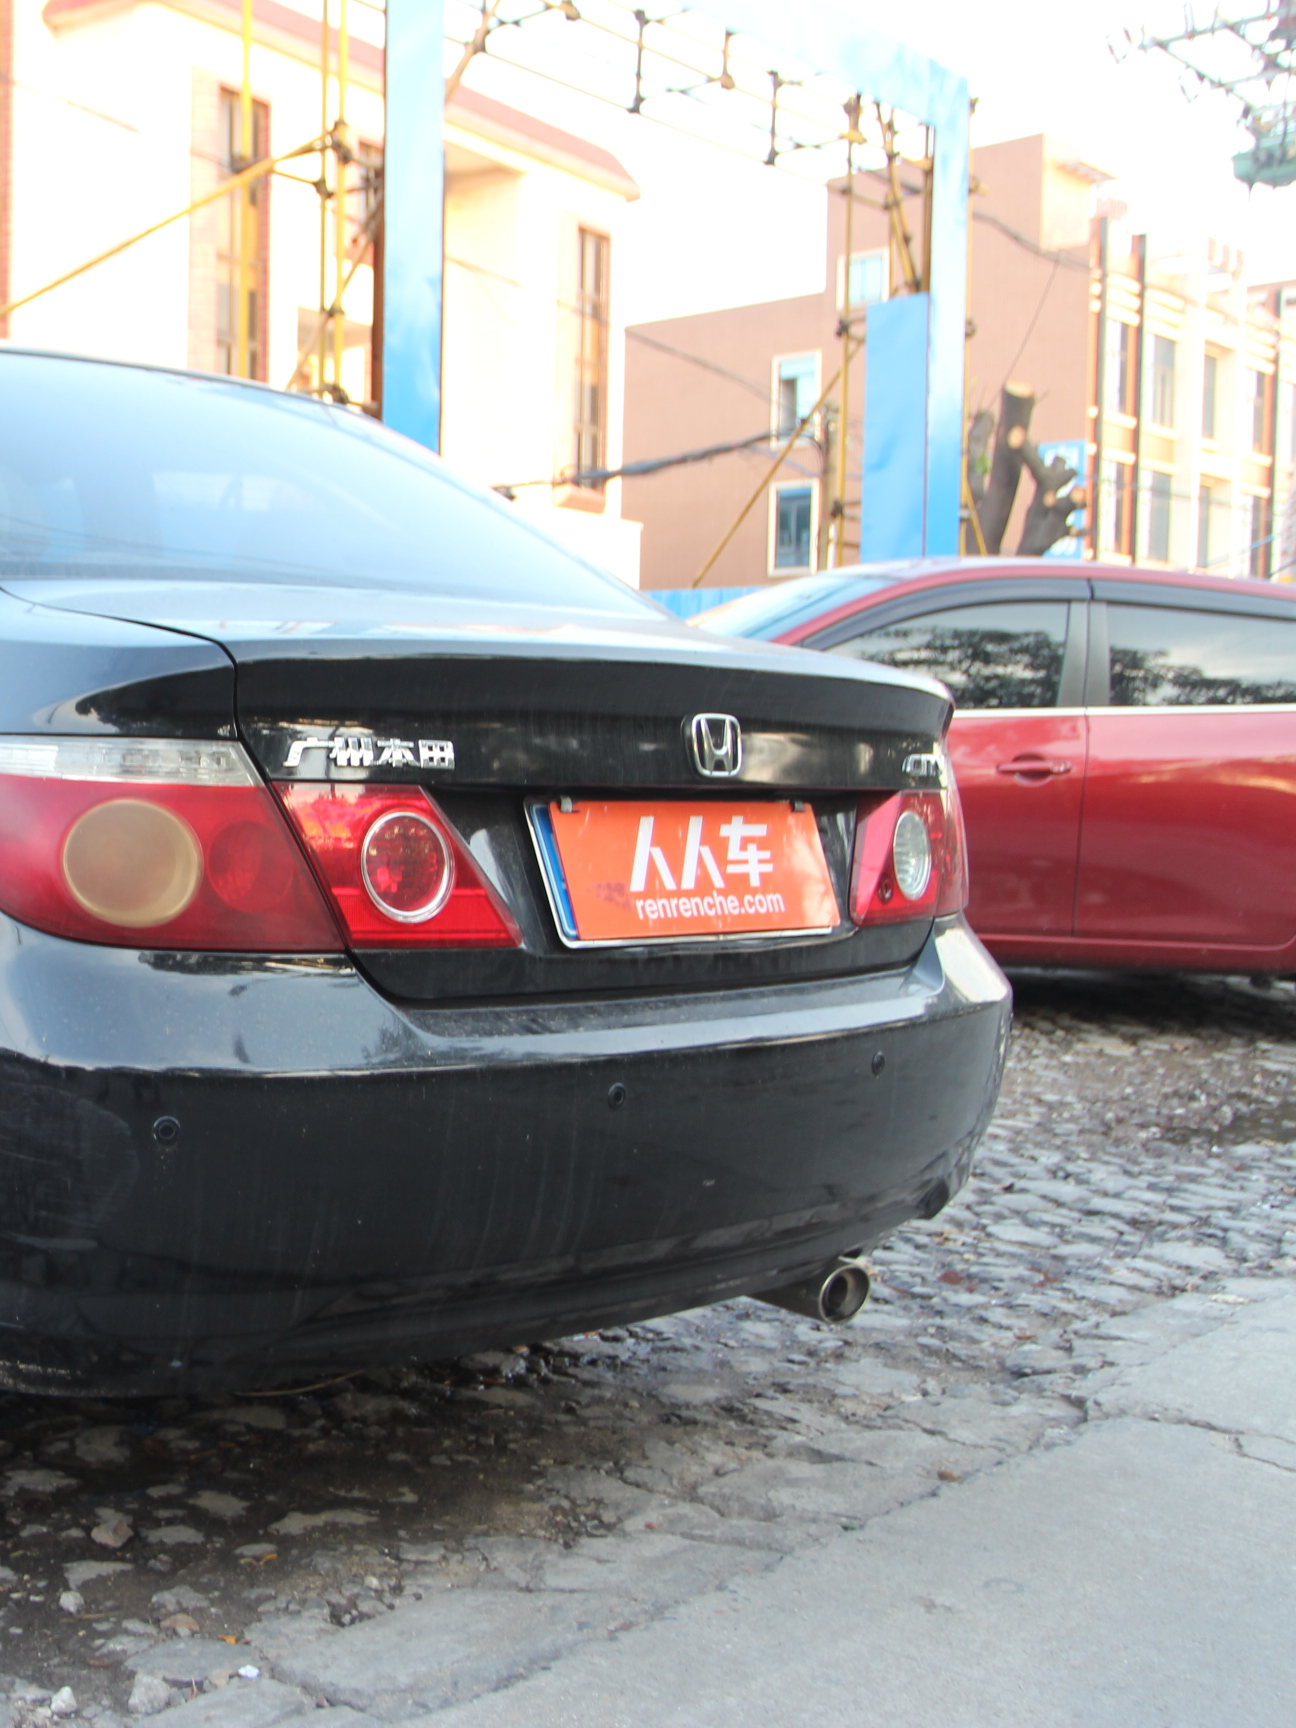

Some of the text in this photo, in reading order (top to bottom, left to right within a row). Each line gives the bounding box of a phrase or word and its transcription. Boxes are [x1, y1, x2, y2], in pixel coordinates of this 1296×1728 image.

[283, 736, 455, 770] 广州本田
[629, 815, 774, 893] 人人车
[635, 890, 786, 920] renrenche.com
